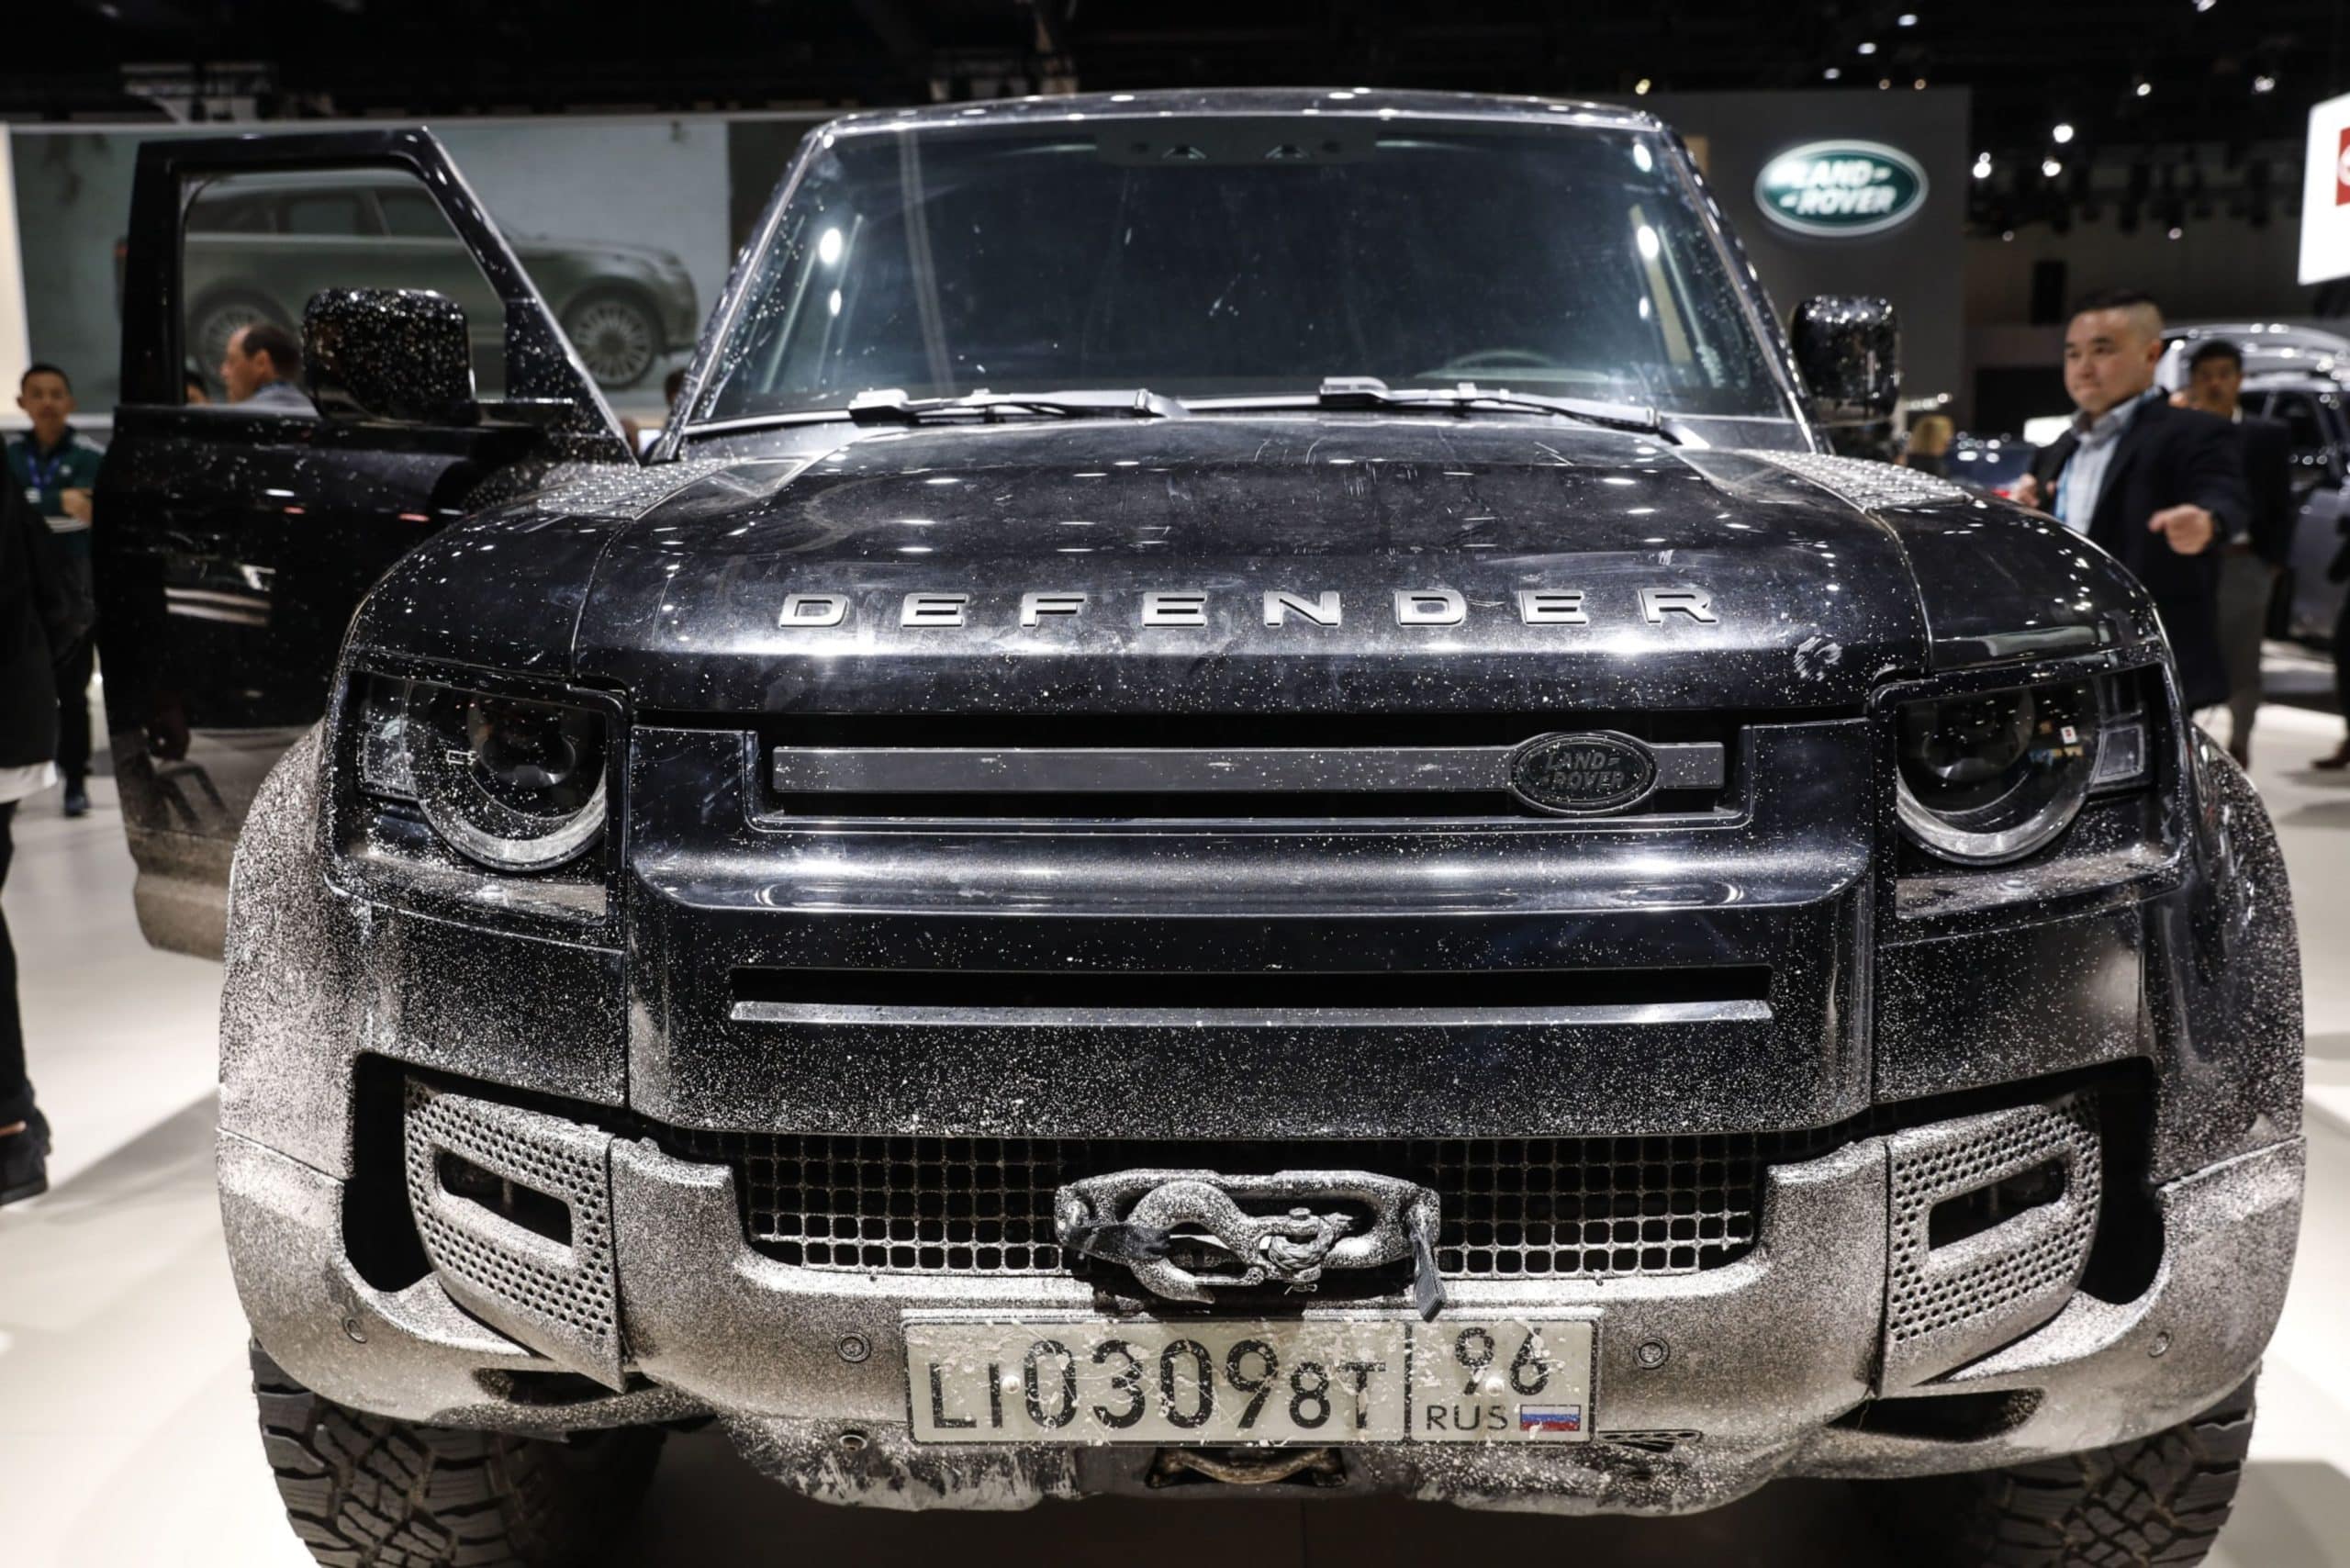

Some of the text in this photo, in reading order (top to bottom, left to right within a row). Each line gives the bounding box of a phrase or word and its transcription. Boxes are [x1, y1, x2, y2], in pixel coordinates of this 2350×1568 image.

[779, 588, 1718, 628] DEFENDER
[1455, 1327, 1550, 1396] 96
[1426, 1405, 1509, 1432] RUS
